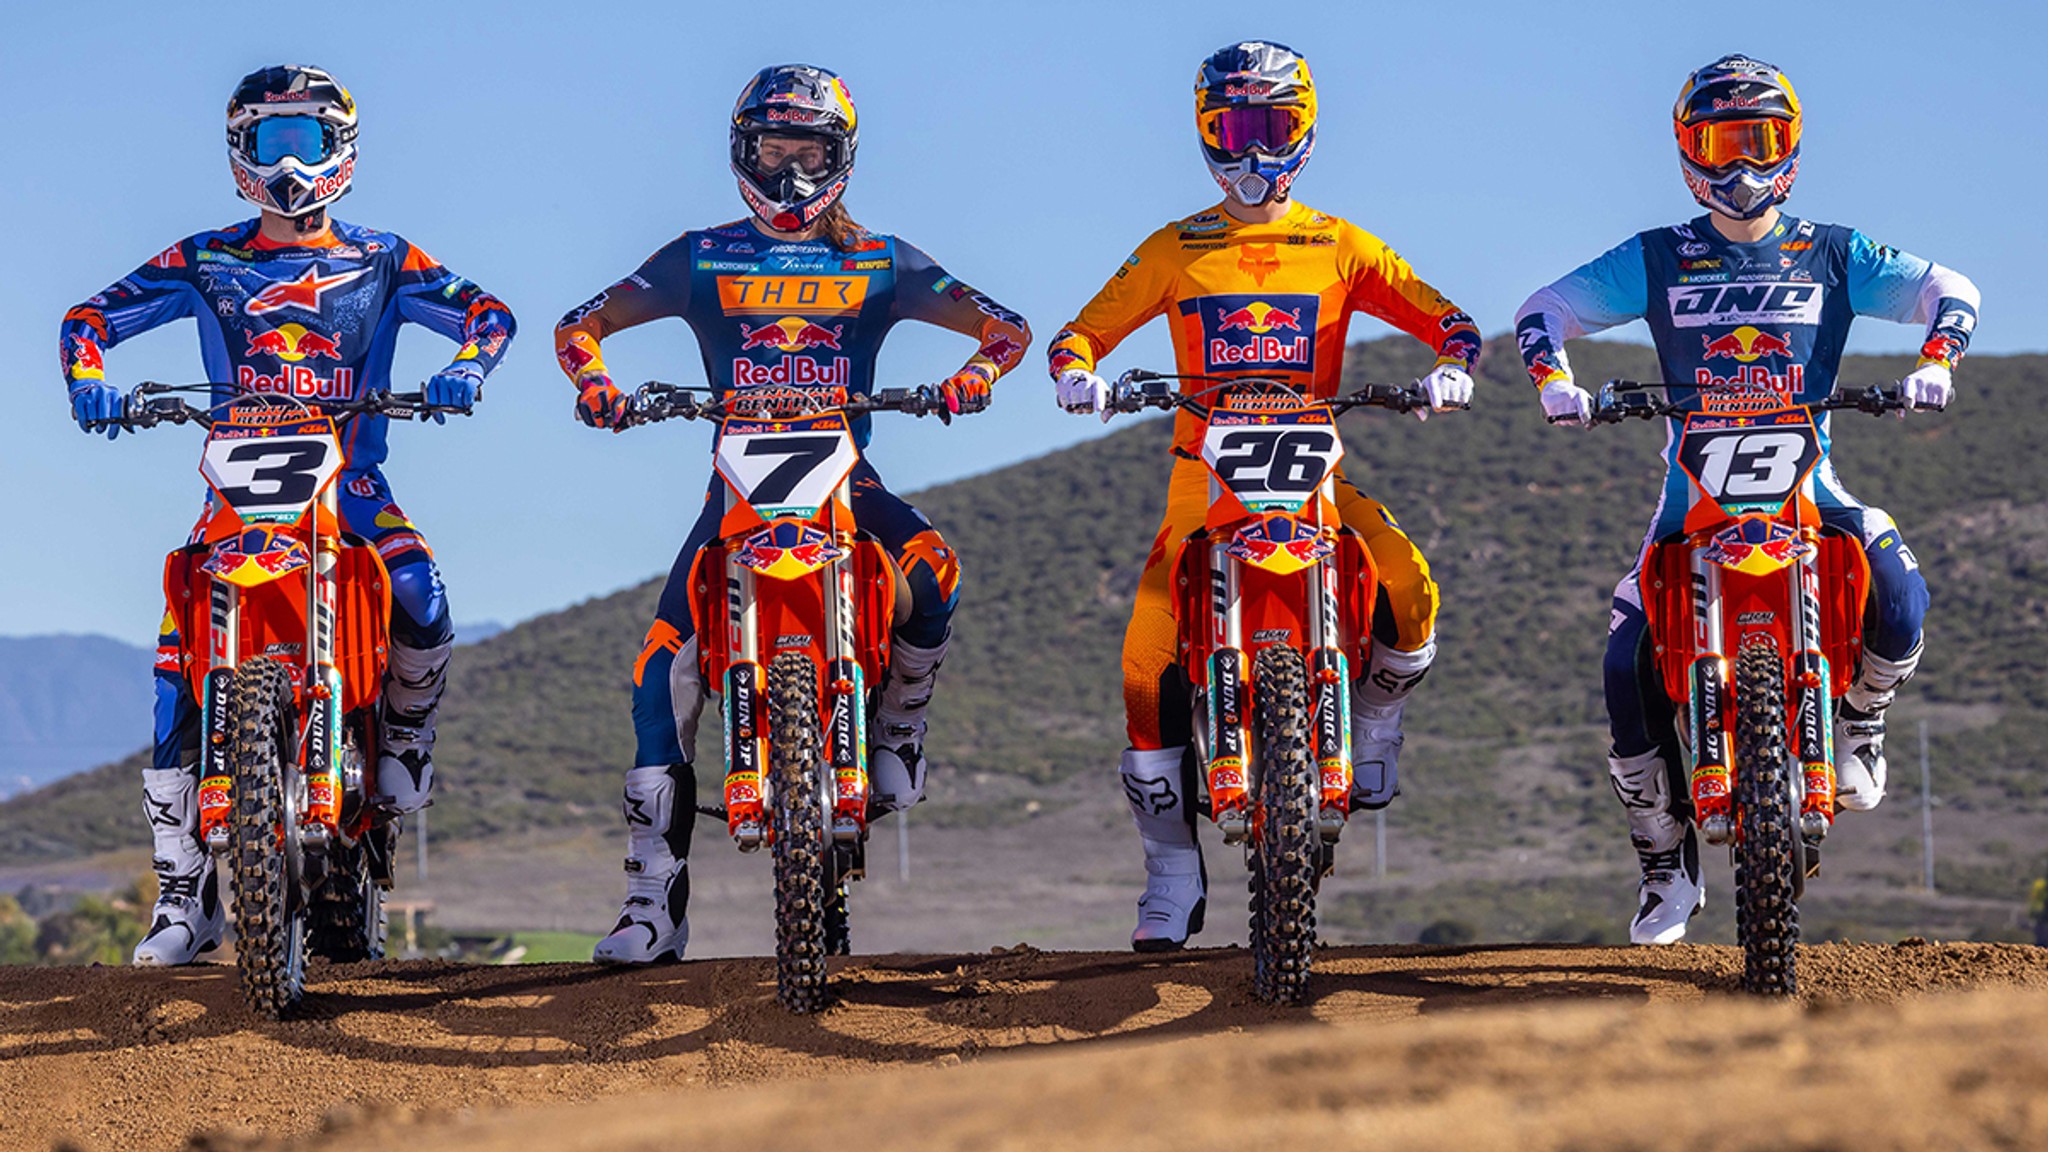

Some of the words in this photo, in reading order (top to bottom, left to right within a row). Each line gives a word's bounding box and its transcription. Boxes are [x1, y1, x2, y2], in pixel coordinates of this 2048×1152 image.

[1226, 85, 1248, 97] Red
[1249, 84, 1272, 96] Bull
[1713, 96, 1737, 110] Red
[767, 109, 790, 121] Red
[792, 109, 814, 122] Bull
[313, 163, 344, 200] Red
[732, 281, 852, 304] THOR
[1211, 335, 1259, 364] Red
[1262, 335, 1308, 364] Bull
[238, 363, 290, 395] Red
[294, 367, 352, 398] Bull
[734, 355, 791, 387] Red
[795, 355, 849, 387] Bull
[1696, 365, 1746, 394] Red
[1750, 364, 1804, 394] Bull
[297, 424, 328, 434] KTM
[811, 420, 842, 430] KTM
[1297, 414, 1328, 424] KTM
[1775, 413, 1805, 424] KTM
[218, 440, 328, 507] 3
[743, 436, 841, 505] 7
[1215, 431, 1334, 492] 26
[1700, 433, 1805, 498] 13
[313, 674, 324, 752] DUNL
[838, 675, 849, 747] DUNL
[1223, 671, 1237, 751] DUNP
[1323, 660, 1335, 736] DUNL
[1805, 664, 1817, 740] DUNL
[213, 691, 228, 771] DUNP
[739, 687, 752, 766] DUNP
[1705, 682, 1719, 759] DUNOP
